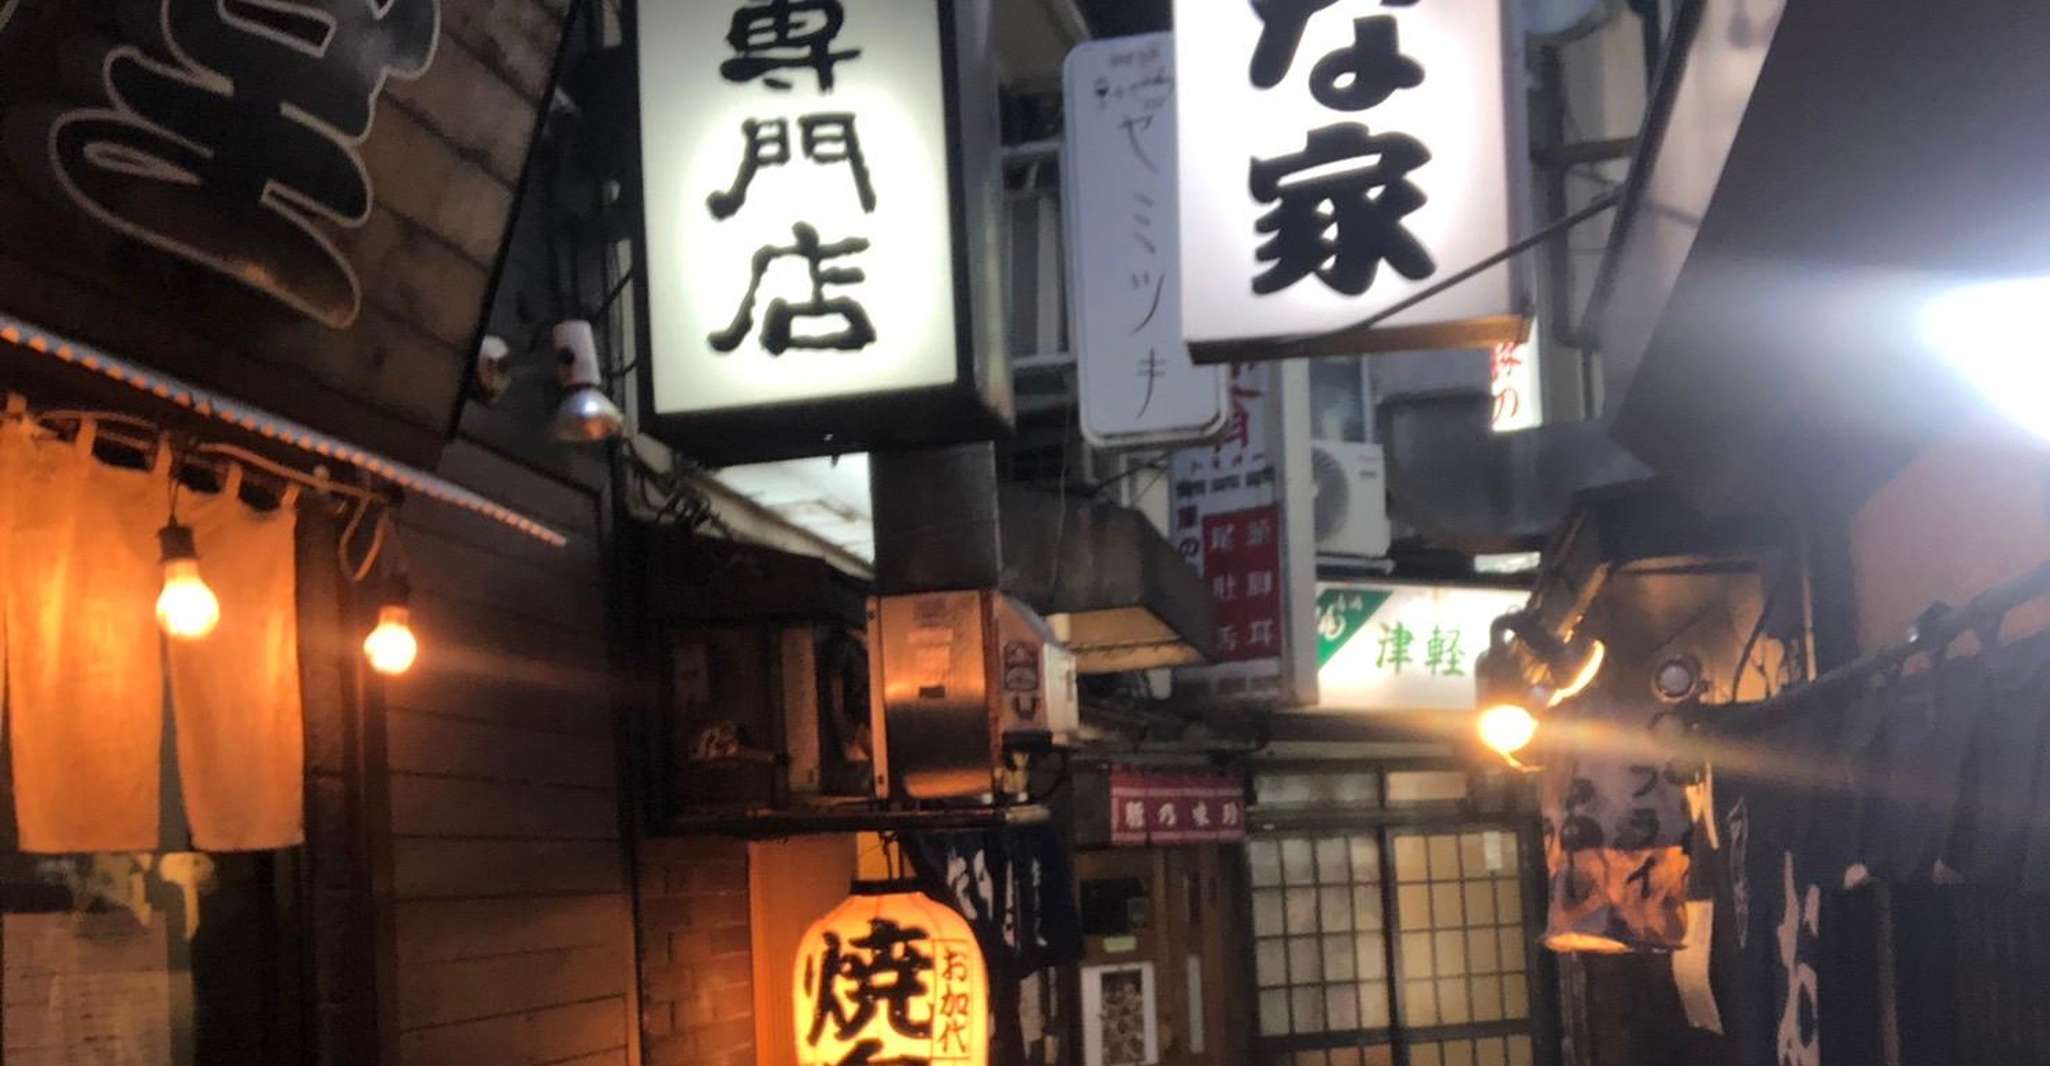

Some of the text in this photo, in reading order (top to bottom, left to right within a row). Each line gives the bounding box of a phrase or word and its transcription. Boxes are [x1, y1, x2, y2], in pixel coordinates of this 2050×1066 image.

[705, 0, 877, 357] 専門店
[1248, 0, 1437, 297] な家
[1120, 114, 1167, 420] ヤミツキ
[1375, 620, 1466, 676] 津軽
[803, 918, 934, 1066] 焼
[940, 948, 969, 1054] お加代
